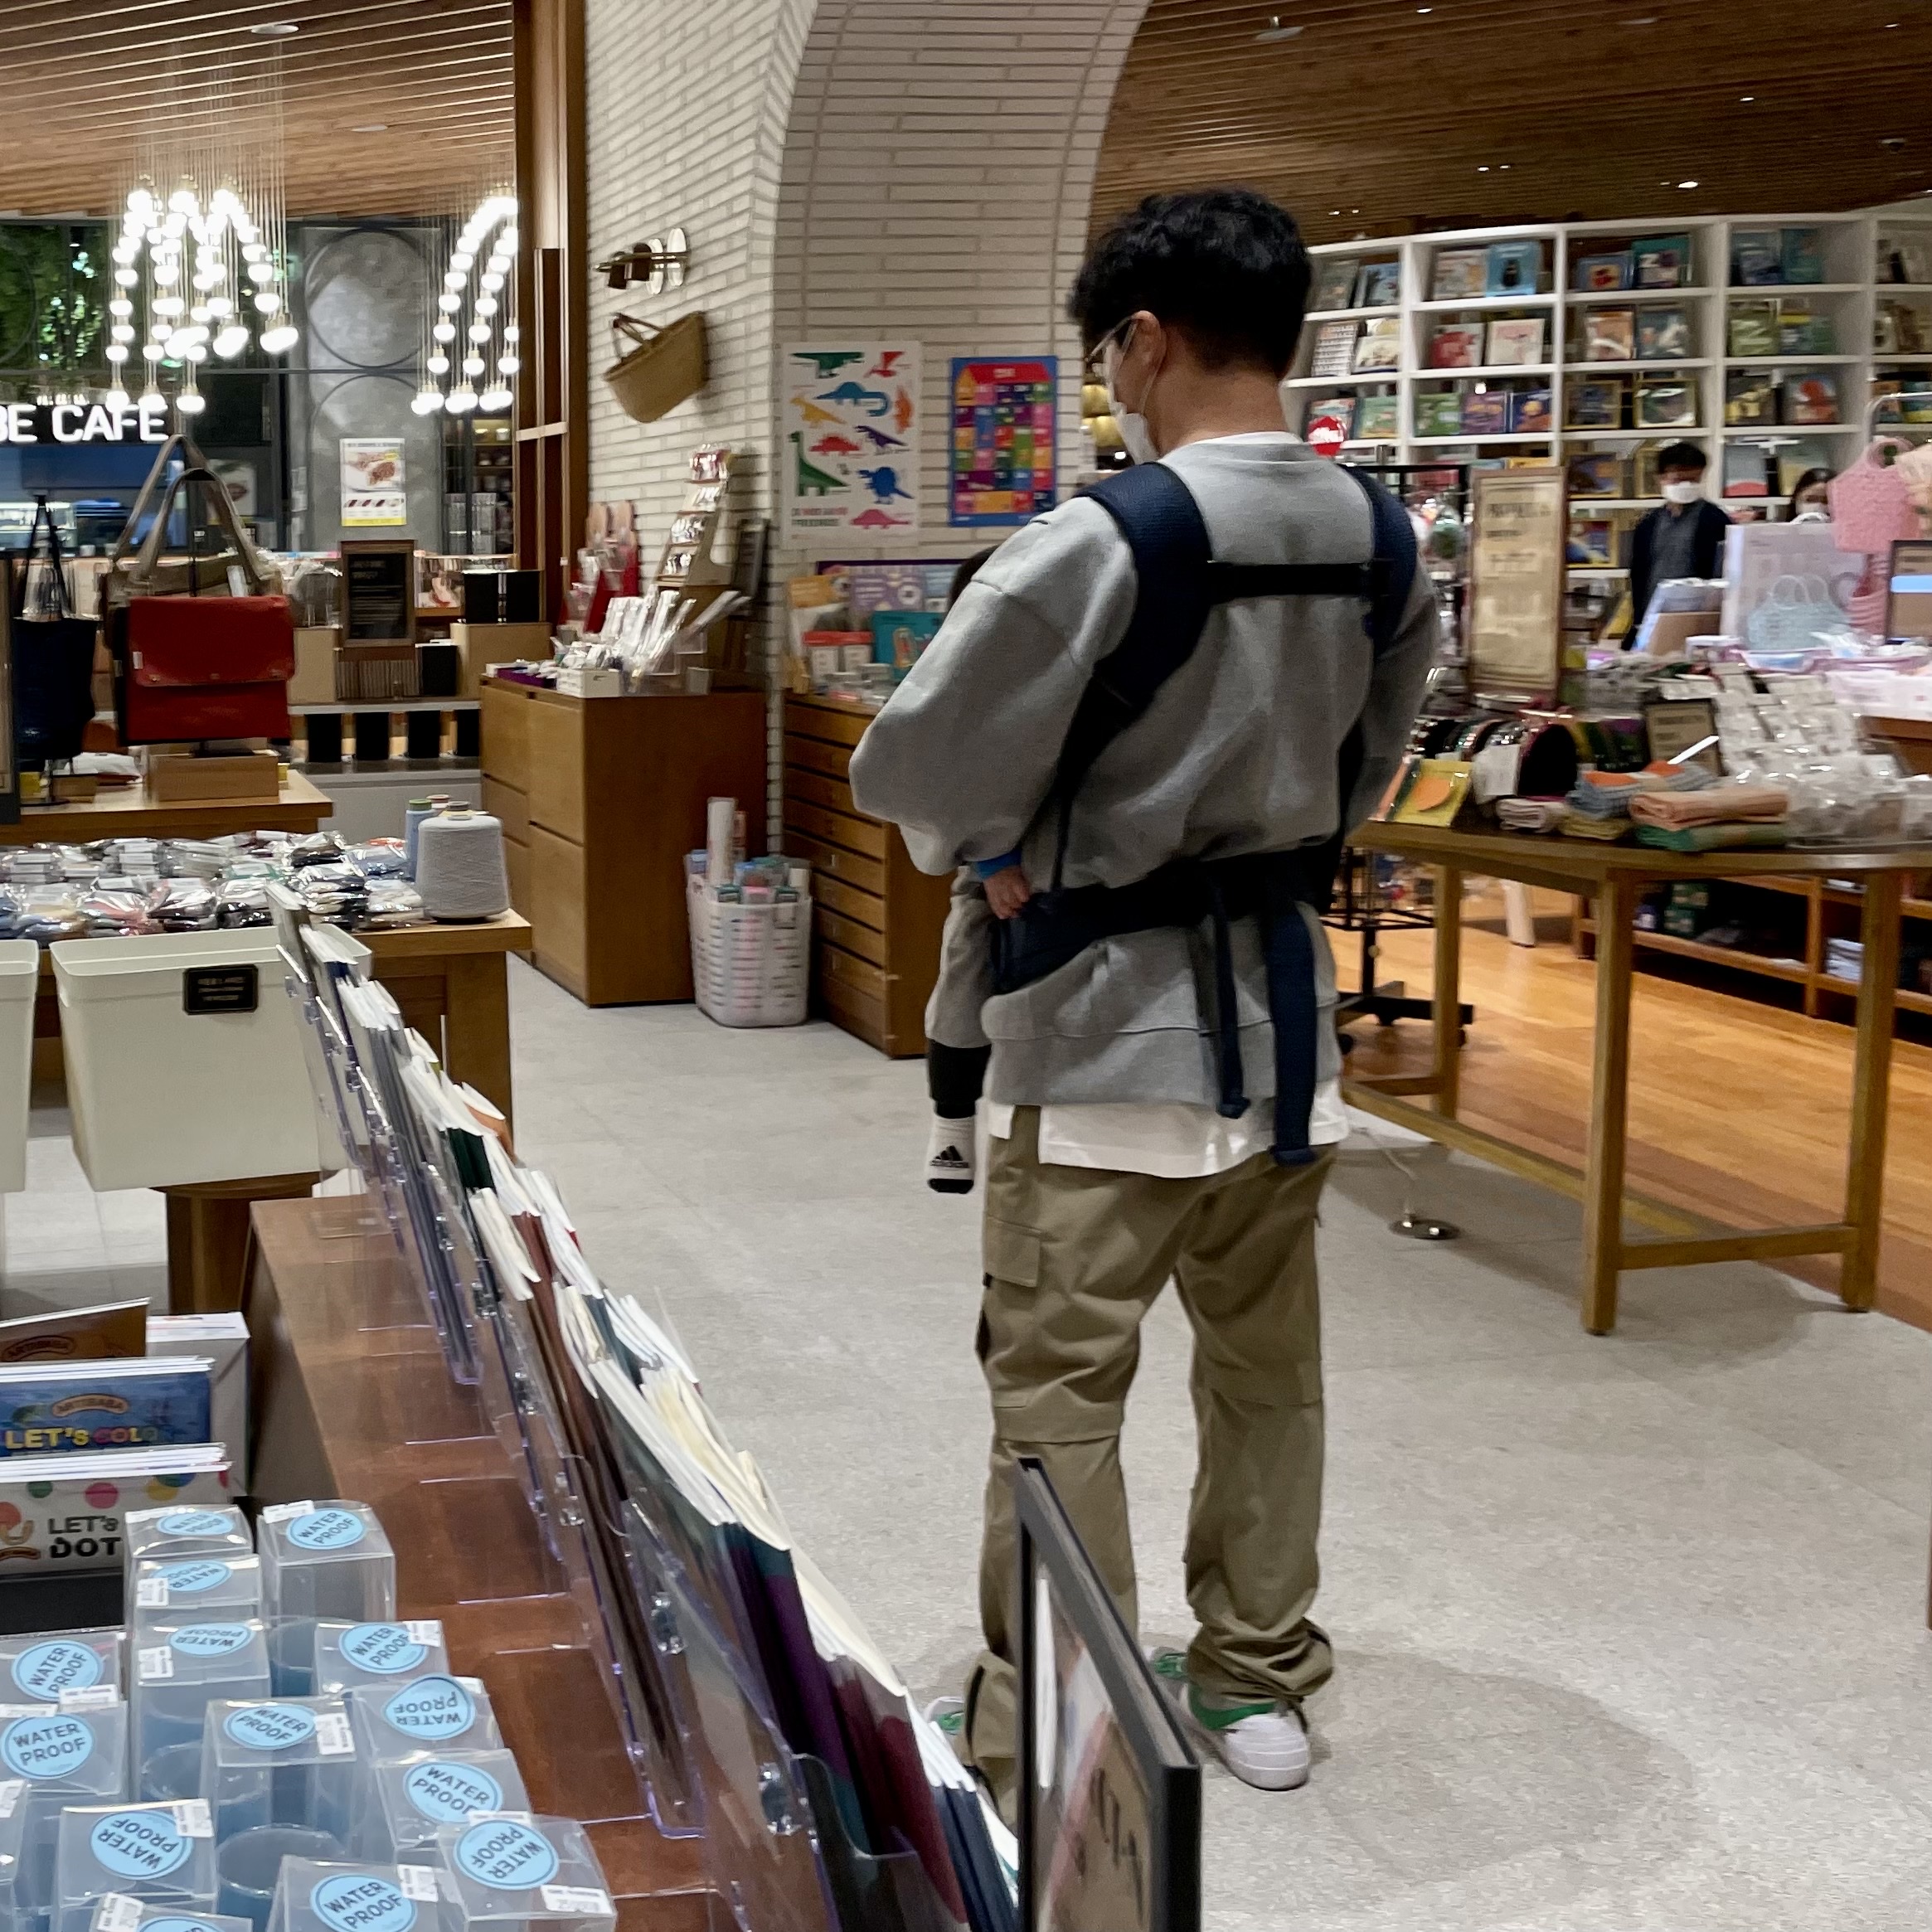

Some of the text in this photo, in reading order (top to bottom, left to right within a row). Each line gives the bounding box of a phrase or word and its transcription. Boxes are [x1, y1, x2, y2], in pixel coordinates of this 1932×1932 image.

[0, 404, 169, 443] E CAFE
[5, 1427, 90, 1450] LET'S
[47, 1515, 119, 1535] LET'S
[170, 1514, 211, 1530] WATER
[299, 1512, 342, 1539] WATER
[313, 1517, 355, 1545] PROOF
[50, 1536, 123, 1559] DOT
[170, 1567, 223, 1589] WATER
[175, 1636, 235, 1647] WATER
[183, 1629, 245, 1638] PROOF
[350, 1627, 396, 1656] WATER
[368, 1633, 410, 1666] PROOF
[26, 1647, 71, 1687] WATER
[46, 1651, 88, 1696] PROOF
[393, 1691, 459, 1714] PROOF
[234, 1715, 293, 1740] PROOF
[256, 1707, 308, 1733] WATER
[396, 1712, 462, 1726] WATER
[13, 1722, 81, 1748] WATER
[19, 1736, 86, 1767] PROOF
[426, 1766, 491, 1804] WATER
[97, 1828, 163, 1870] WATER
[110, 1818, 180, 1853] PROOF
[470, 1825, 525, 1869] PROOF
[488, 1841, 545, 1880] WATER
[323, 1881, 388, 1914] WATER
[343, 1893, 404, 1930] PROOF
